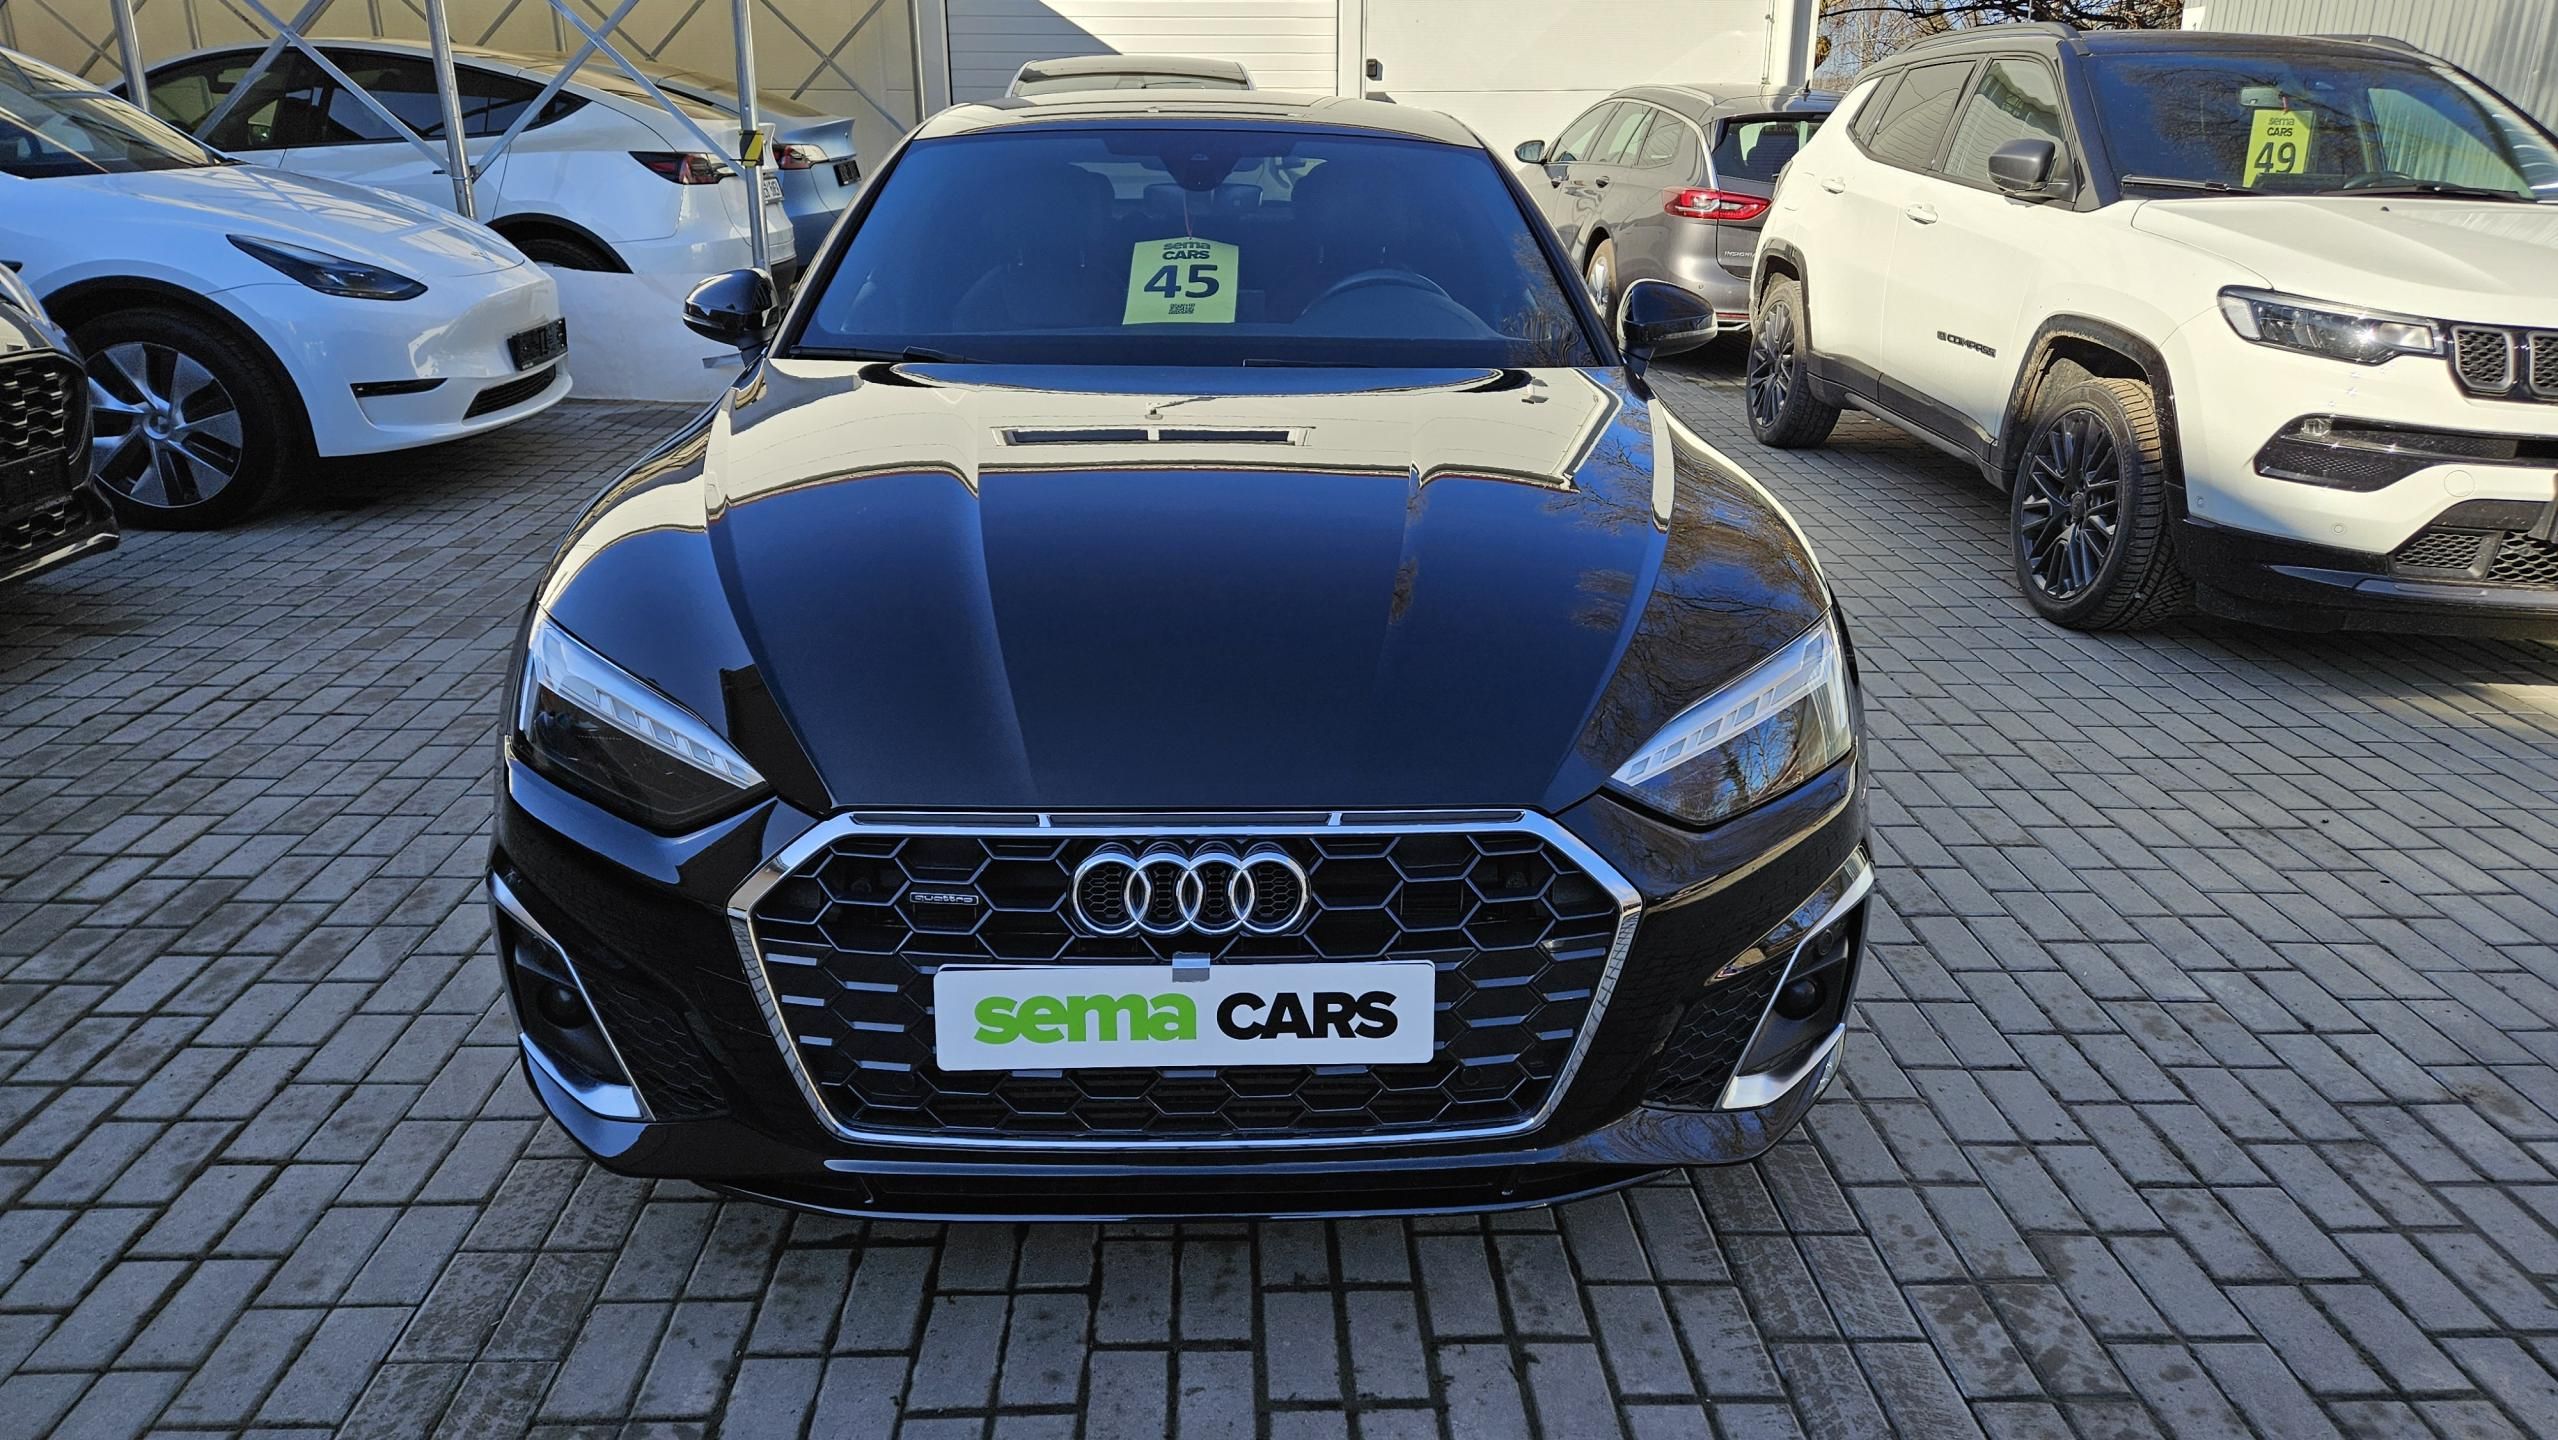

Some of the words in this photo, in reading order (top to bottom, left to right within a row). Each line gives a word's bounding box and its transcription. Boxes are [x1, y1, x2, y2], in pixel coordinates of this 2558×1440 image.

[2267, 127, 2293, 137] CARS
[2254, 142, 2296, 174] 49
[1163, 241, 1211, 251] sema
[1162, 249, 1210, 260] CARS
[1143, 264, 1220, 299] 45
[914, 894, 974, 904] quattro
[973, 992, 1198, 1045] sema
[1216, 990, 1400, 1041] CARS
